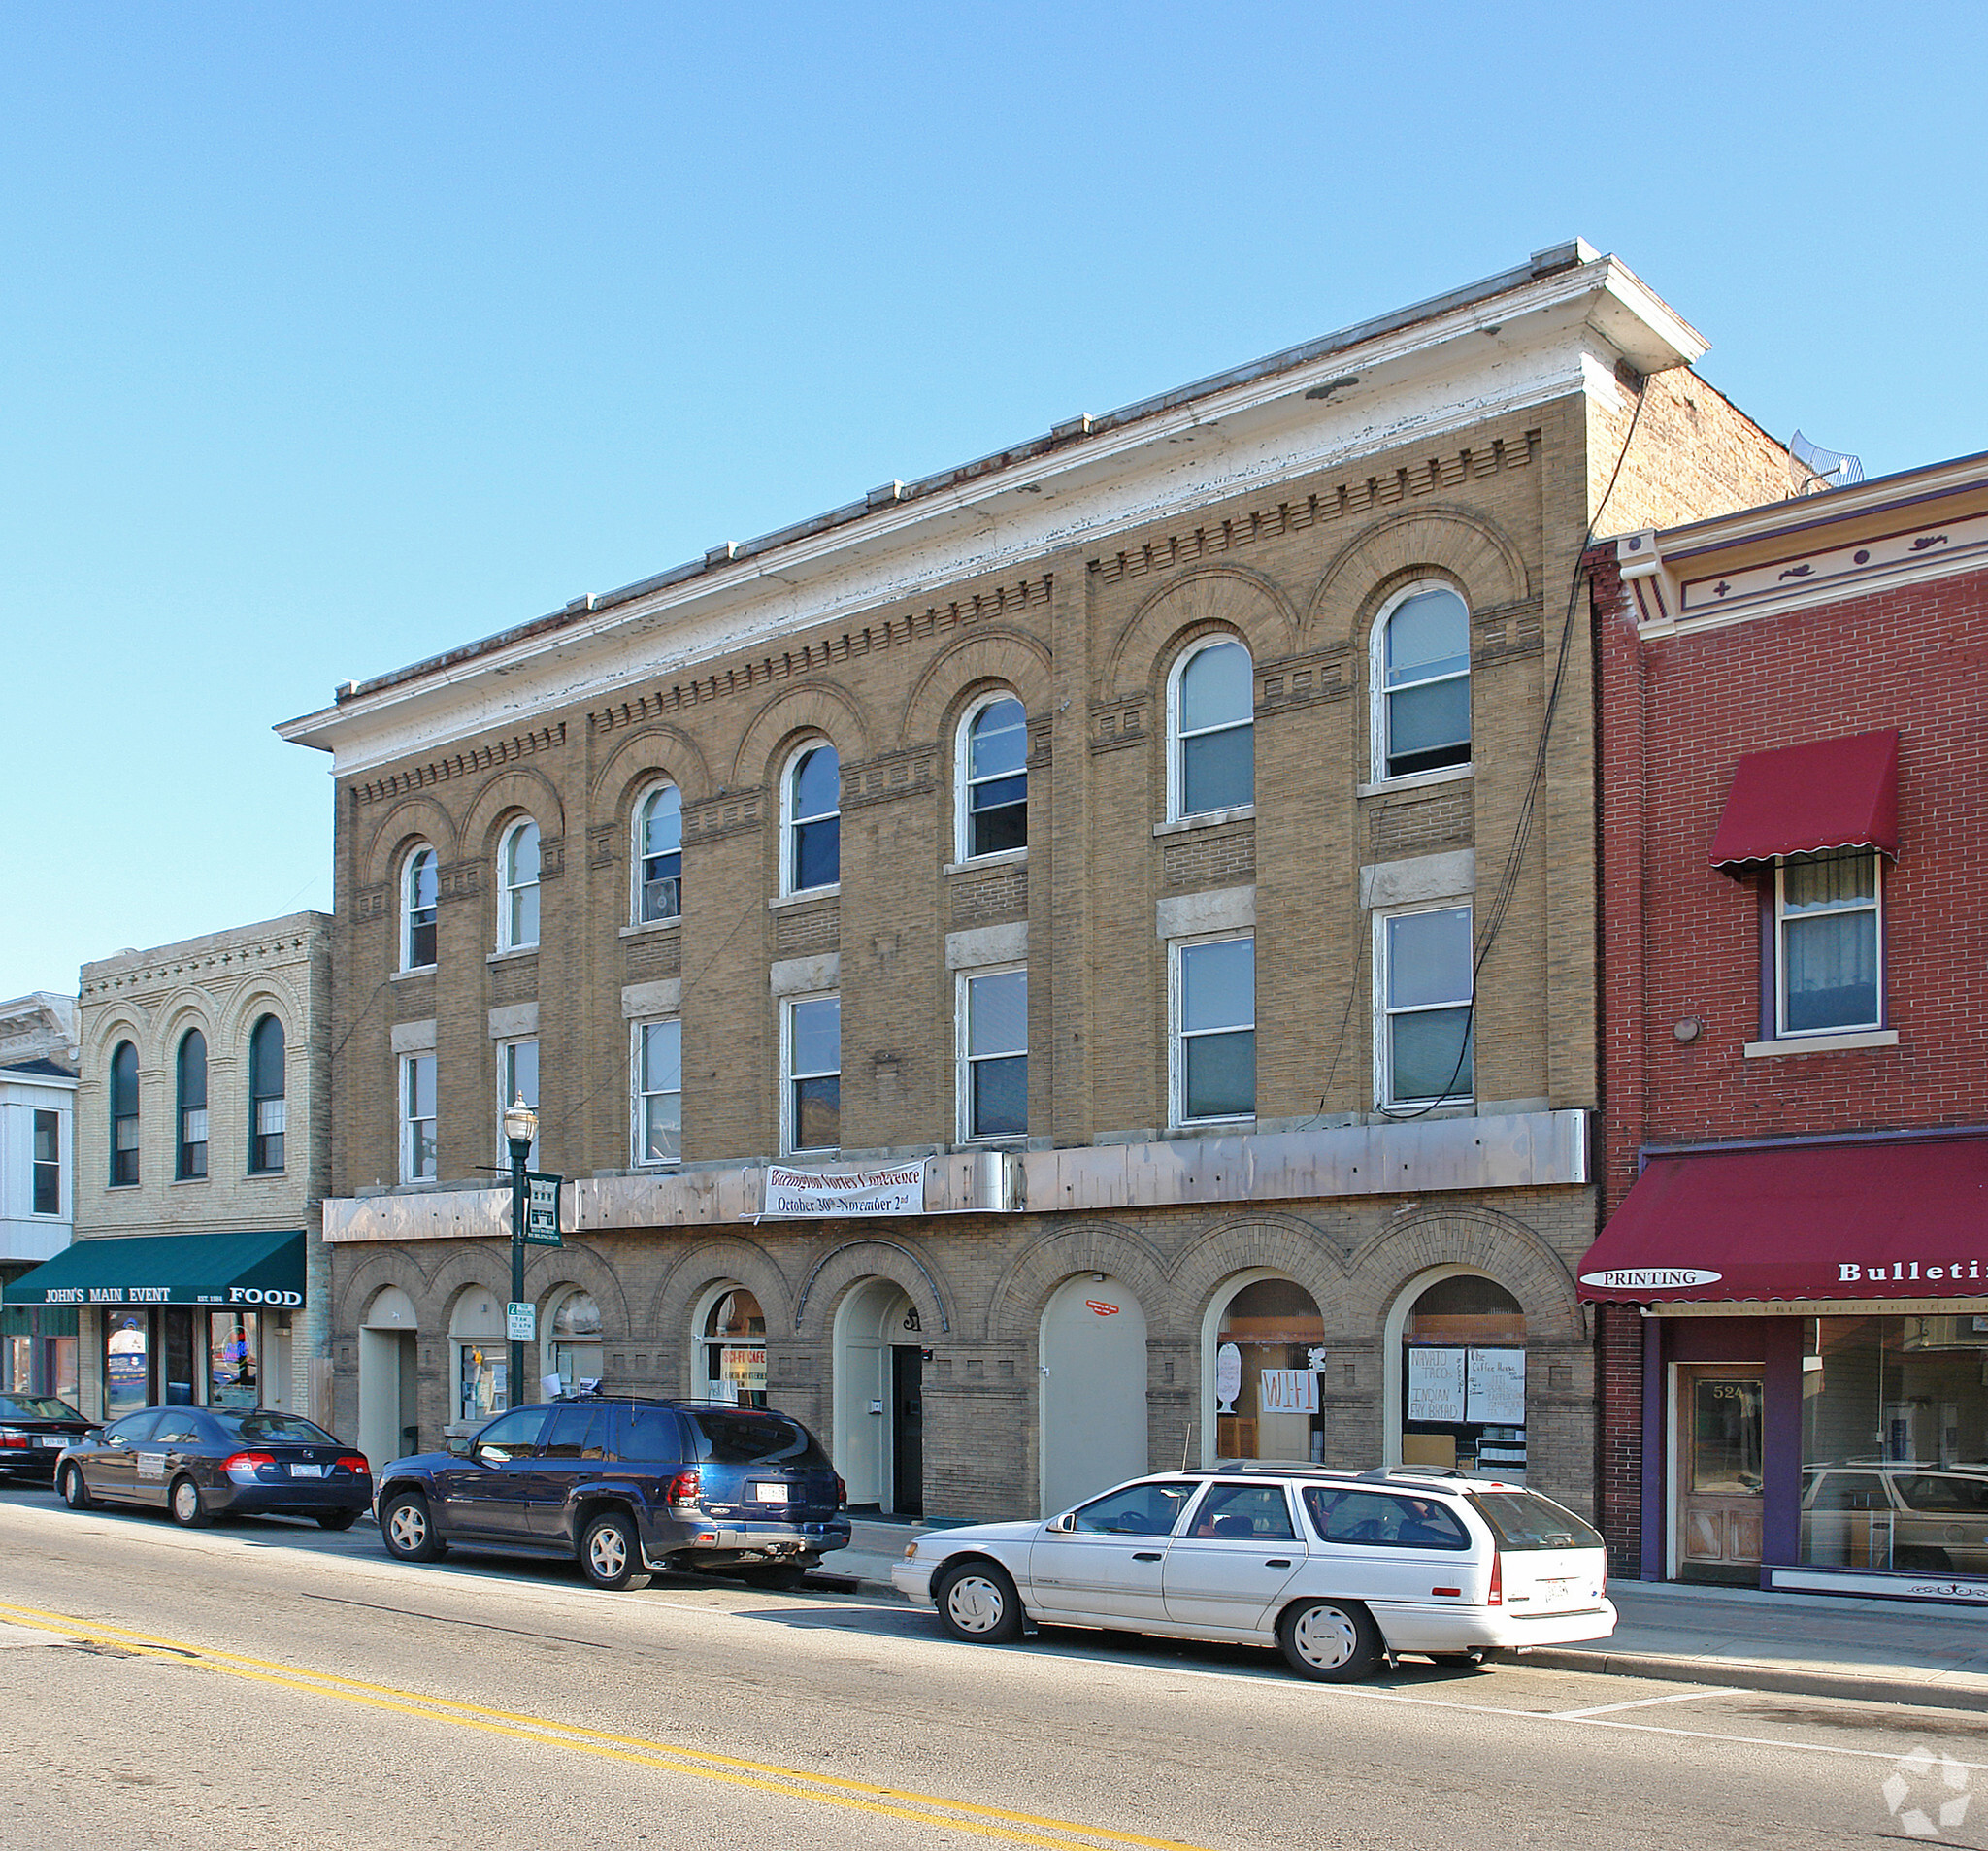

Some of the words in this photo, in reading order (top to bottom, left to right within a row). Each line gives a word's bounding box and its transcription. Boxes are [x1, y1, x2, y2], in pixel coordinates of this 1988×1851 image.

[771, 1169, 823, 1192] Burlington
[821, 1173, 858, 1190] Vortex
[857, 1171, 920, 1188] Conference
[778, 1196, 815, 1212] October
[894, 1194, 909, 1210] 2nd
[1603, 1270, 1698, 1286] PRINTING
[1838, 1260, 1988, 1282] Bulleti
[45, 1287, 84, 1303] JOHN'S
[89, 1288, 123, 1303] MAIN
[128, 1287, 171, 1302] EVENT
[228, 1286, 303, 1306] FOOD
[510, 1305, 517, 1314] 2
[722, 1350, 746, 1364] SCI-FI
[746, 1350, 766, 1364] CAFE
[1410, 1350, 1448, 1367] NAVAJO
[1713, 1385, 1745, 1399] 524
